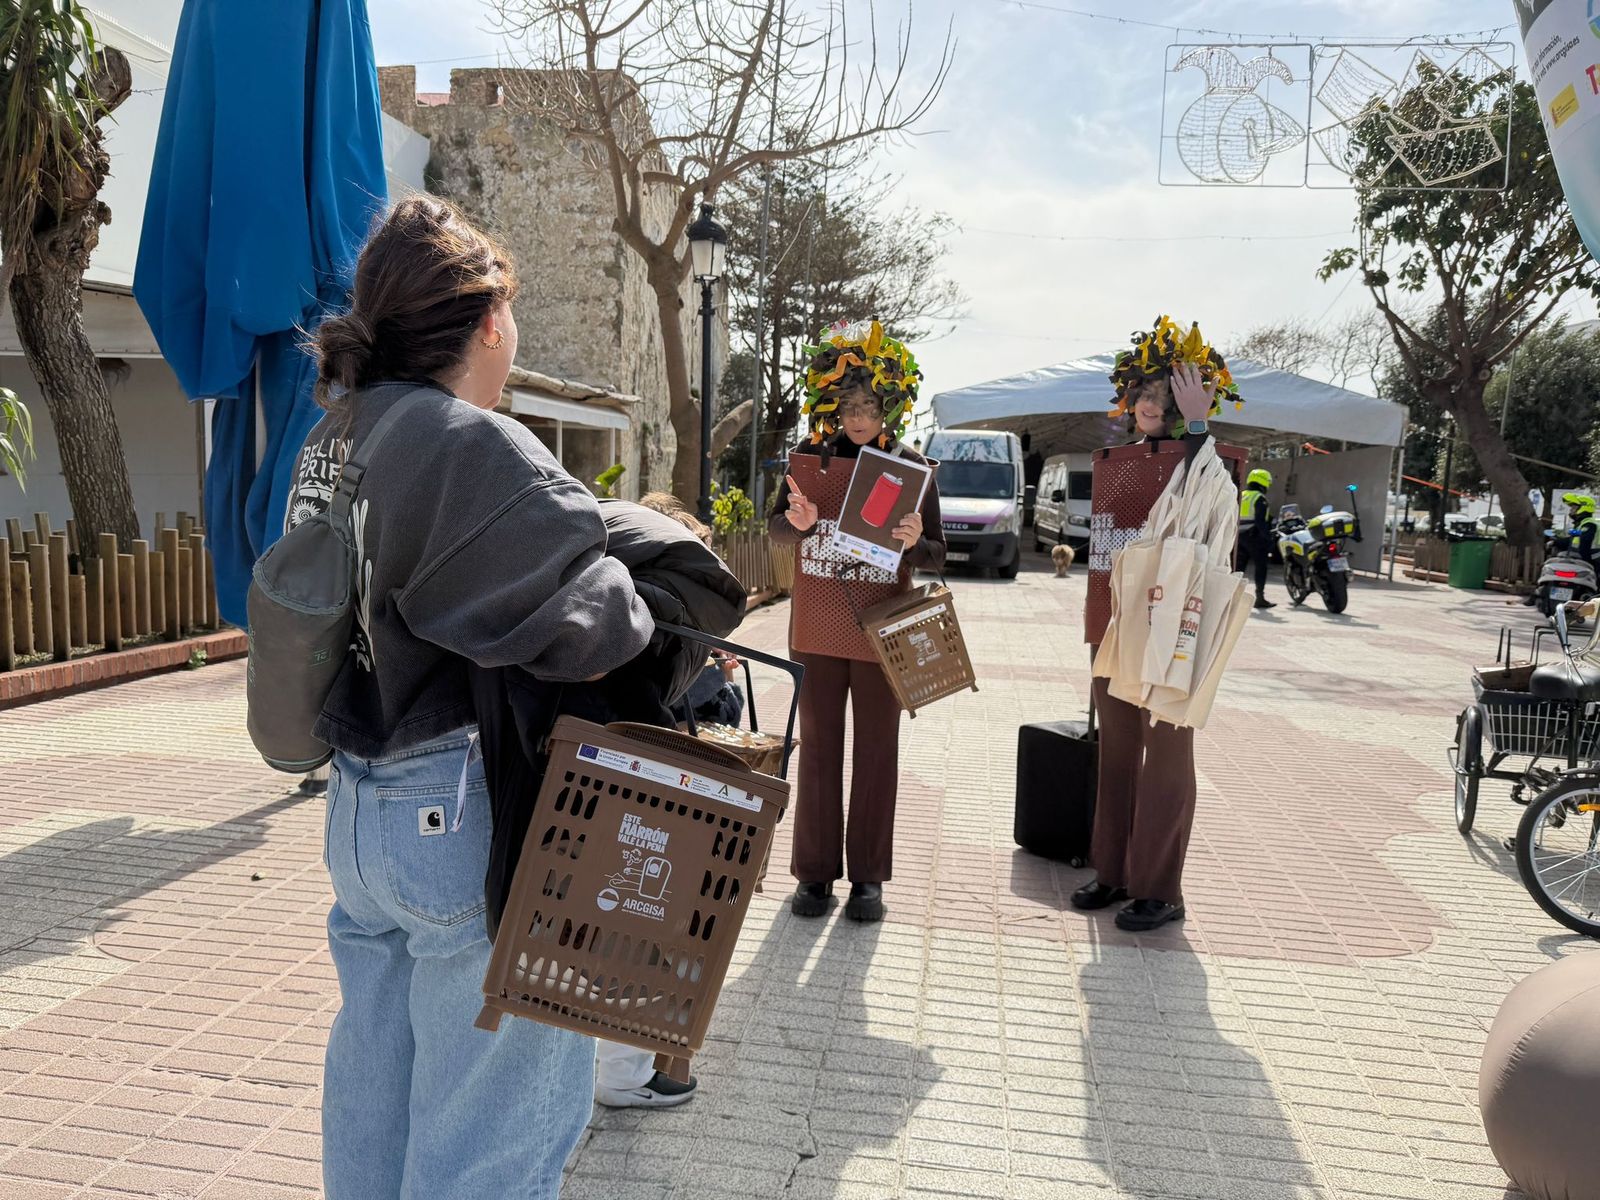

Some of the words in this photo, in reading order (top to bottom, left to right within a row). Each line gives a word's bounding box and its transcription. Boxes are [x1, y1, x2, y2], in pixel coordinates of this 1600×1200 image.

[943, 522, 969, 530] IVECO
[623, 813, 642, 825] ESTE
[617, 833, 636, 845] VALE
[635, 839, 645, 848] LA
[646, 841, 666, 853] PENA
[619, 821, 669, 845] MARRÓN
[622, 898, 665, 918] ARCGISA
